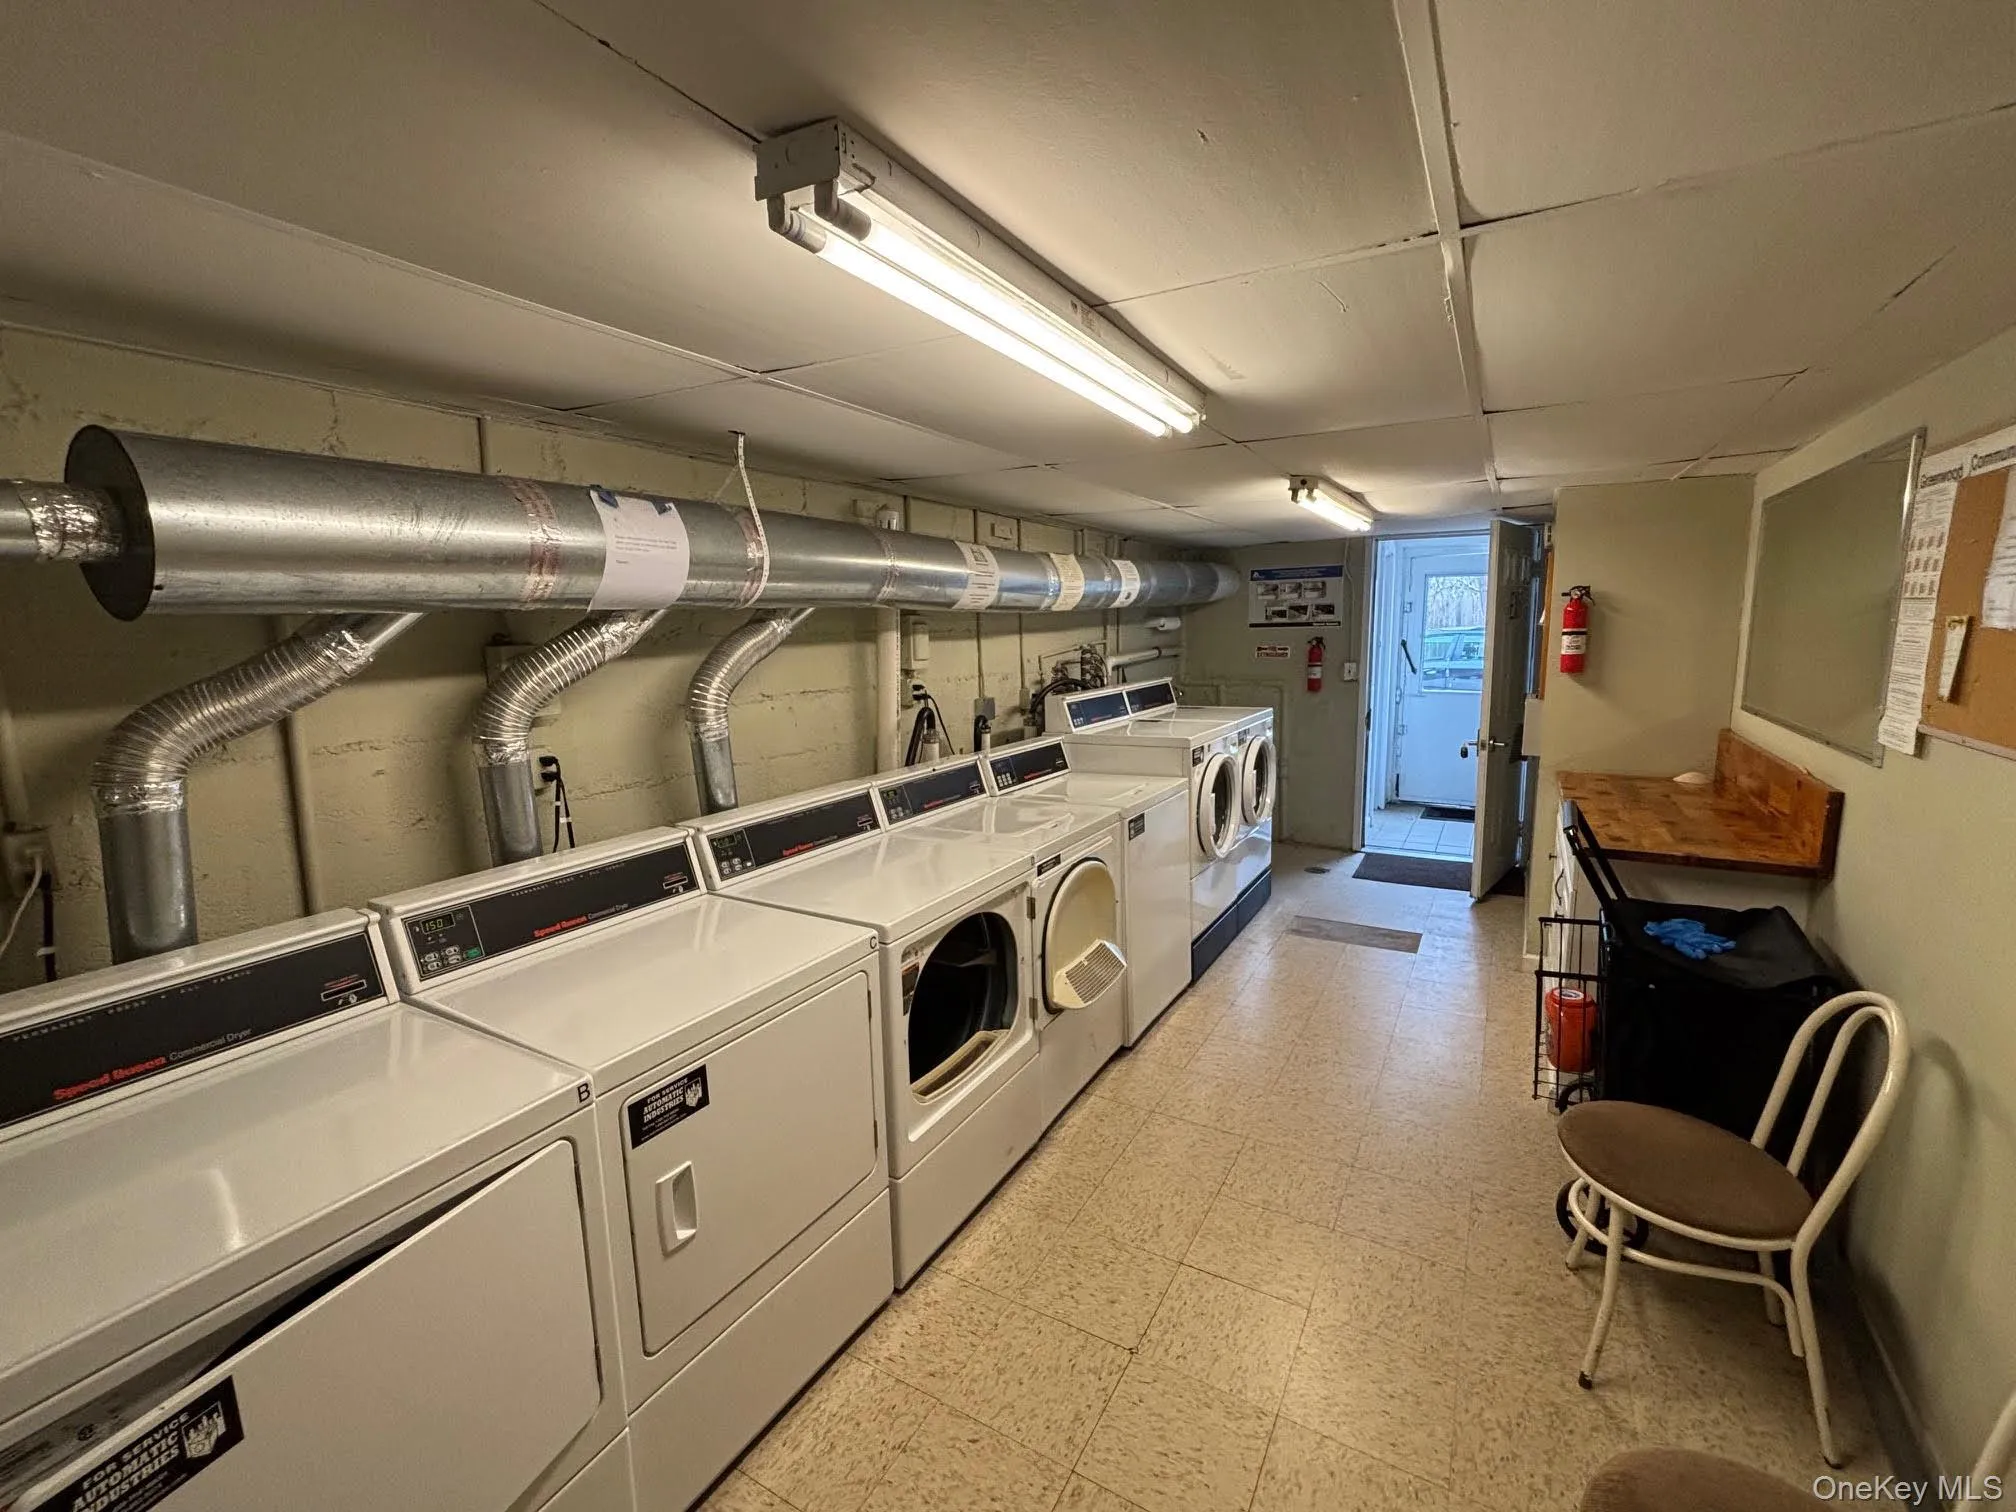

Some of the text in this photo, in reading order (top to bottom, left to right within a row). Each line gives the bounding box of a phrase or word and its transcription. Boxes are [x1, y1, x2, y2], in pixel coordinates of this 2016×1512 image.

[425, 918, 443, 931] 150
[533, 923, 561, 938] Speed
[561, 915, 588, 928] Queen
[869, 936, 877, 949] C
[53, 1028, 253, 1100] Speed Queen Commercial Dryer
[577, 1082, 591, 1103] B
[643, 1086, 684, 1115] AUTOMATIC
[647, 1077, 688, 1104] FOR SERVICE
[643, 1095, 684, 1123] INDUSTRIES
[82, 1412, 190, 1490] FOR SERVICE
[72, 1430, 180, 1512] AUTOMATIC
[83, 1444, 181, 1512] NDUSTRIES
